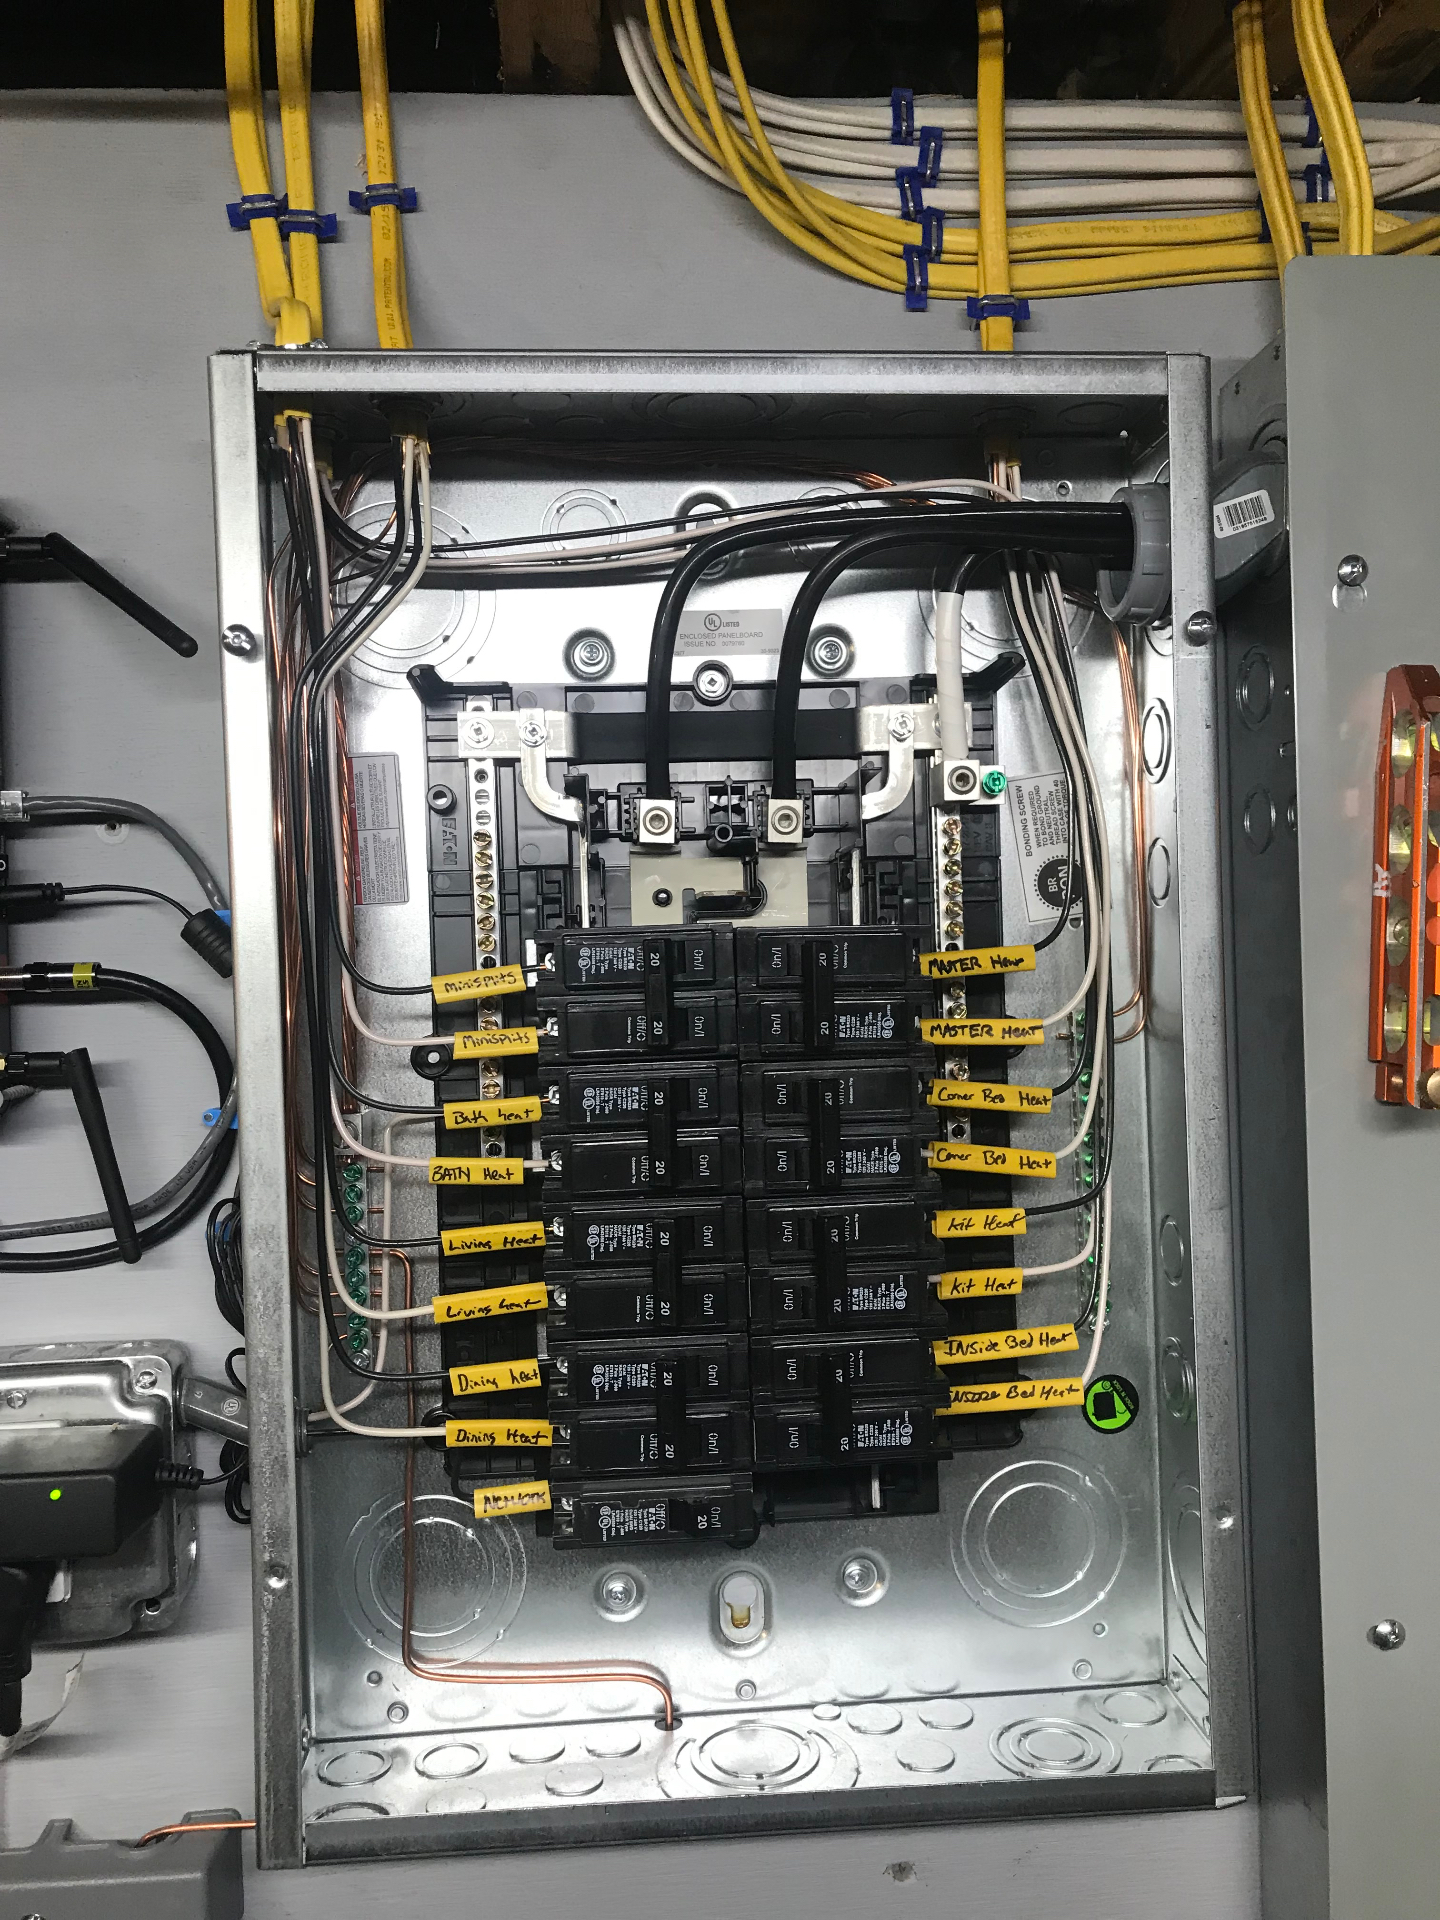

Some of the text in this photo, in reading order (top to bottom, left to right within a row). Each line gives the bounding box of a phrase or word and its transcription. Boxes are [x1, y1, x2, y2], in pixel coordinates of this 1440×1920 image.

[1053, 779, 1060, 788] 40
[1015, 785, 1033, 857] BONDING SCREW
[1028, 790, 1042, 848] WHEN REQUIRED
[1034, 785, 1049, 847] TO BOND GROUND
[1049, 790, 1062, 845] THREAD SCREW
[1048, 877, 1059, 892] BR
[650, 952, 660, 966] 20
[819, 952, 827, 966] 20
[654, 1021, 663, 1034] 20
[821, 1022, 829, 1035] 20
[654, 1092, 664, 1105] 20
[656, 1160, 665, 1174] 20
[826, 1160, 835, 1174] 20
[152, 1188, 172, 1206] MADE
[174, 1175, 184, 1187] IN
[184, 1158, 198, 1174] USA
[660, 1232, 670, 1246] 20
[660, 1301, 670, 1315] 20
[834, 1299, 842, 1313] 20
[663, 1372, 672, 1386] 20
[665, 1444, 674, 1458] 20
[841, 1437, 849, 1451] 20
[698, 1515, 707, 1529] 20
